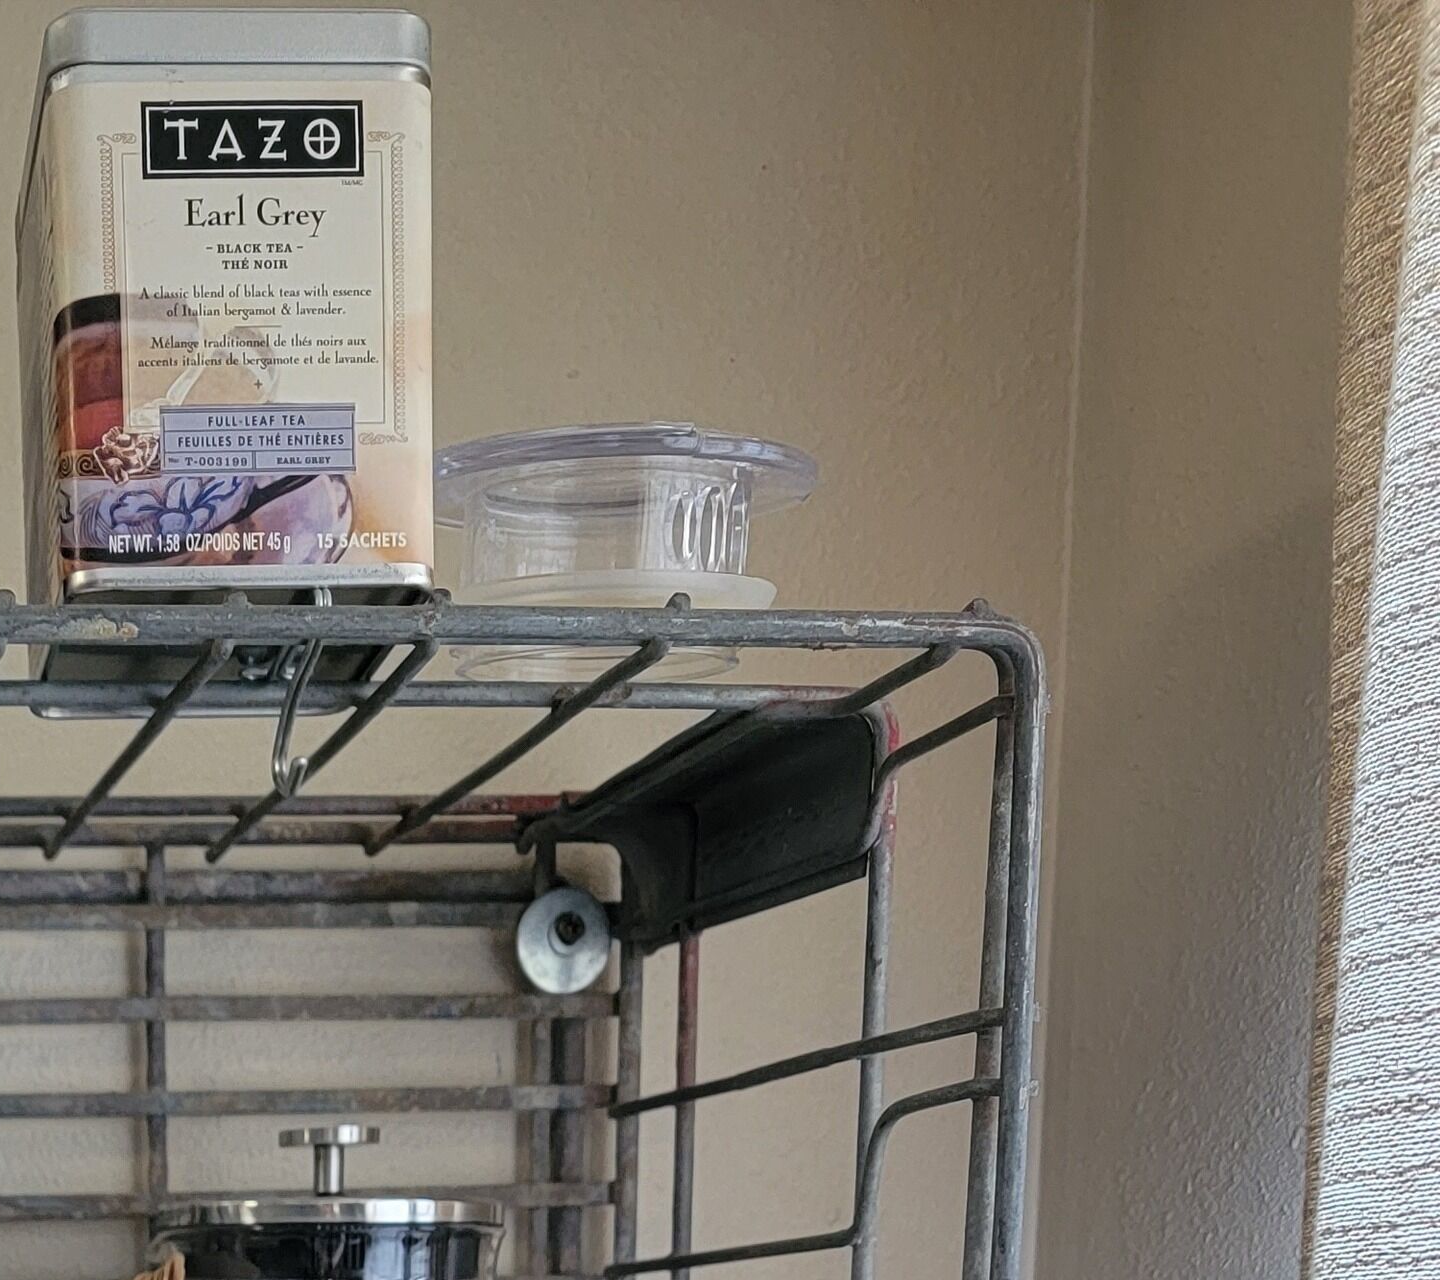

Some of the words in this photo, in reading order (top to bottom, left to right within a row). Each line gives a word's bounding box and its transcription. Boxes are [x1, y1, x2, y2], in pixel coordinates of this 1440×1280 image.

[163, 117, 341, 162] TAZO
[183, 193, 247, 227] Earl
[256, 197, 327, 237] Grey
[216, 243, 262, 254] BLACK
[266, 243, 293, 254] TEA
[222, 257, 250, 270] THÉ
[253, 259, 288, 270] NOIR
[139, 287, 150, 300] A
[153, 285, 189, 299] classic
[193, 284, 225, 299] blend
[228, 283, 242, 299] of
[244, 283, 275, 298] black
[279, 287, 300, 298] teas
[303, 282, 329, 297] with
[332, 287, 372, 297] essence
[166, 302, 180, 318] of
[182, 302, 220, 317] Italian
[224, 302, 276, 320] bergamot
[281, 303, 292, 316] &
[296, 301, 346, 316] lavender.
[150, 336, 199, 353] Mélange
[203, 334, 270, 349] traditionnel
[273, 335, 287, 348] de
[291, 333, 312, 348] thés
[316, 334, 343, 347] noirs
[347, 337, 367, 347] aux
[137, 354, 178, 367] accents
[182, 352, 222, 367] italiens
[226, 352, 239, 366] de
[242, 351, 300, 369] bergamote
[303, 353, 314, 365] et
[317, 351, 331, 365] de
[334, 350, 379, 365] lavande.
[208, 415, 275, 427] FULL-LEAF
[282, 414, 306, 427] TEA
[177, 435, 232, 448] FEUILLES
[238, 435, 253, 447] DE
[258, 432, 281, 447] THÉ
[287, 431, 345, 446] ENTIÈRES
[276, 456, 303, 465] EARL
[305, 456, 332, 465] GREY
[108, 534, 132, 554] NET
[133, 533, 154, 553] WT.
[156, 533, 180, 553] 1.58
[185, 532, 241, 552] OZ/POIDS
[243, 531, 265, 551] NET
[266, 531, 281, 550] 45
[284, 534, 291, 553] g
[316, 532, 334, 549] 15
[338, 531, 407, 549] SACHETS
